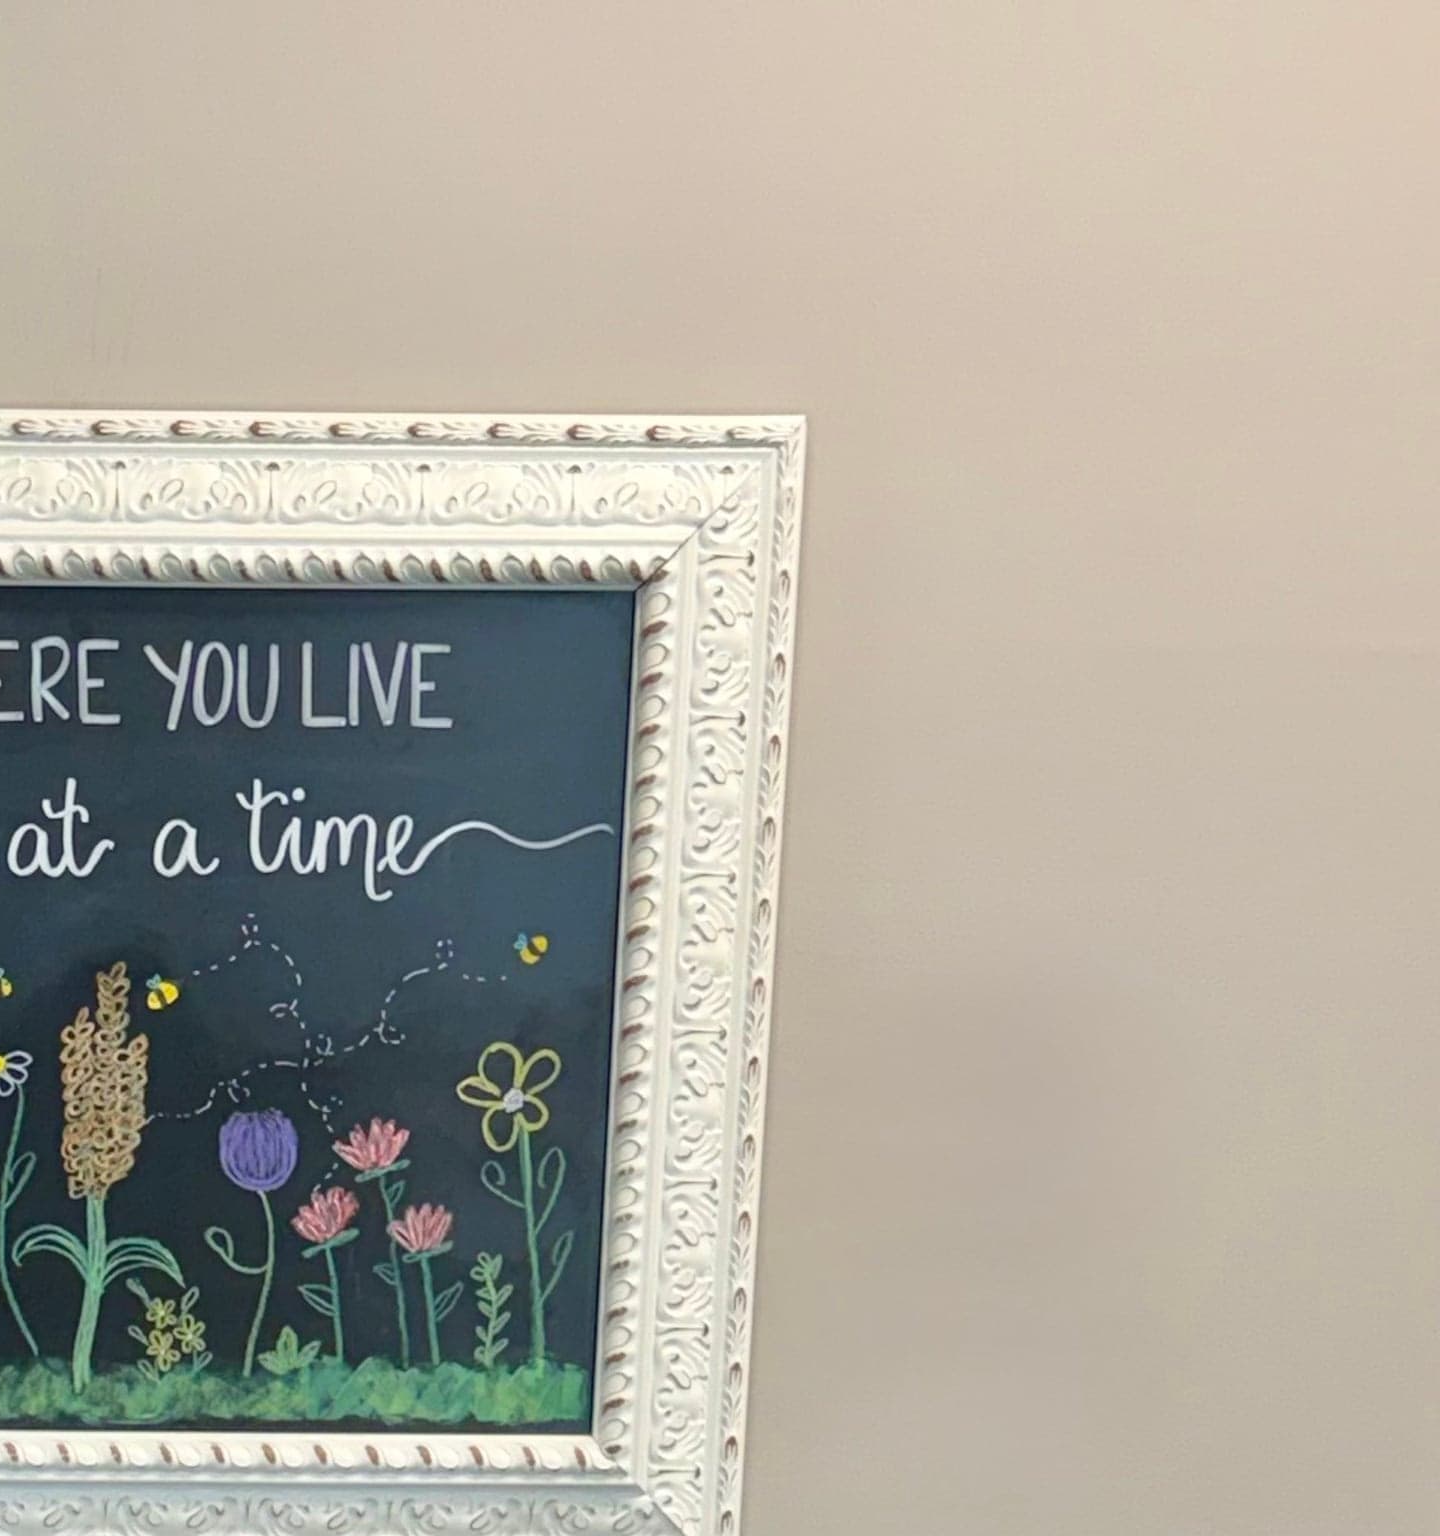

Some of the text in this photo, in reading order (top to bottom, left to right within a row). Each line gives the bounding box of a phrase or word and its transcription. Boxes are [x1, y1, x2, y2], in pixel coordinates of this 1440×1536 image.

[144, 640, 279, 731] YOU
[302, 641, 453, 728] LIVE
[6, 777, 115, 878] at
[153, 818, 220, 878] a
[236, 778, 430, 901] time
